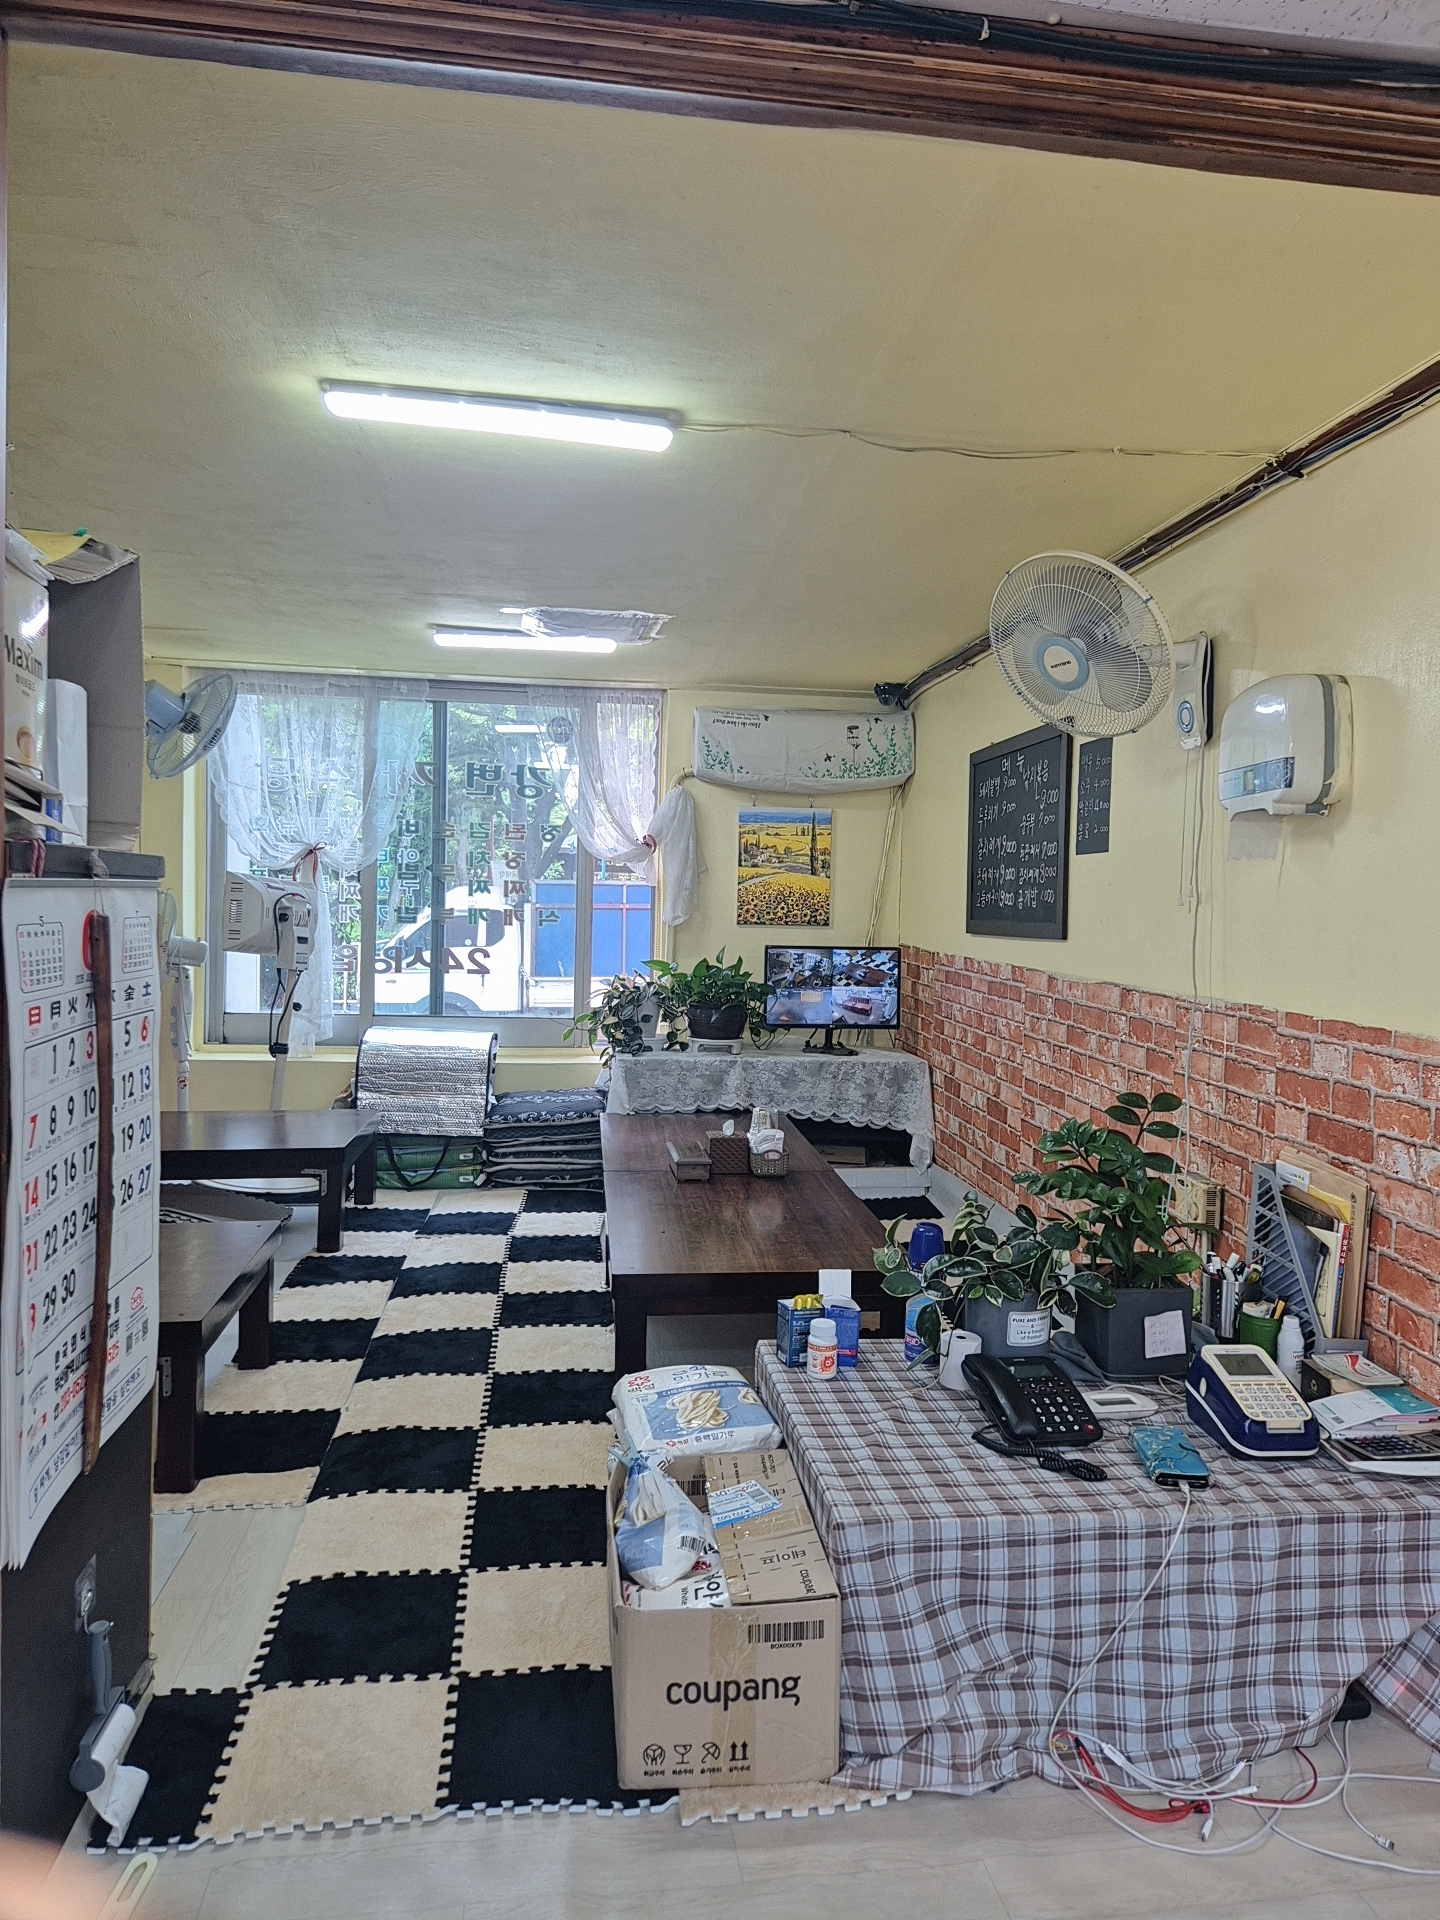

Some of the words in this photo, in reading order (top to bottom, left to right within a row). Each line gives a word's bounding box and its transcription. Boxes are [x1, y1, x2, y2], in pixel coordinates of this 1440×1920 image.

[29, 1005, 41, 1027] 日
[51, 1000, 61, 1020] 月
[68, 996, 77, 1015] 火
[124, 985, 135, 1001] 金
[142, 982, 151, 997] 土
[52, 1044, 57, 1074] 1
[69, 1037, 75, 1067] 2
[86, 1031, 94, 1060] 3
[124, 1020, 131, 1047] 5
[141, 1016, 148, 1042] 6
[29, 1114, 38, 1149] 7
[50, 1104, 57, 1136] 8
[68, 1096, 75, 1126] 9
[84, 1086, 97, 1118] 10
[122, 1071, 134, 1100] 12
[140, 1065, 150, 1094] 13
[25, 1176, 38, 1214] 14
[46, 1163, 58, 1200] 15
[64, 1152, 77, 1187] 16
[83, 1140, 96, 1174] 17
[121, 1123, 134, 1153] 19
[139, 1114, 151, 1144] 20
[44, 1224, 58, 1263] 22
[62, 1210, 77, 1247] 23
[82, 1197, 98, 1233] 24
[120, 1174, 134, 1206] 26
[138, 1163, 152, 1195] 27
[43, 1284, 57, 1326] 29
[61, 1268, 76, 1305] 30
[694, 1430, 735, 1443] 중력밀가루
[759, 1549, 807, 1565] 테이프
[680, 1586, 689, 1607] White
[799, 1568, 817, 1594] coupang
[666, 1676, 801, 1711] coupang
